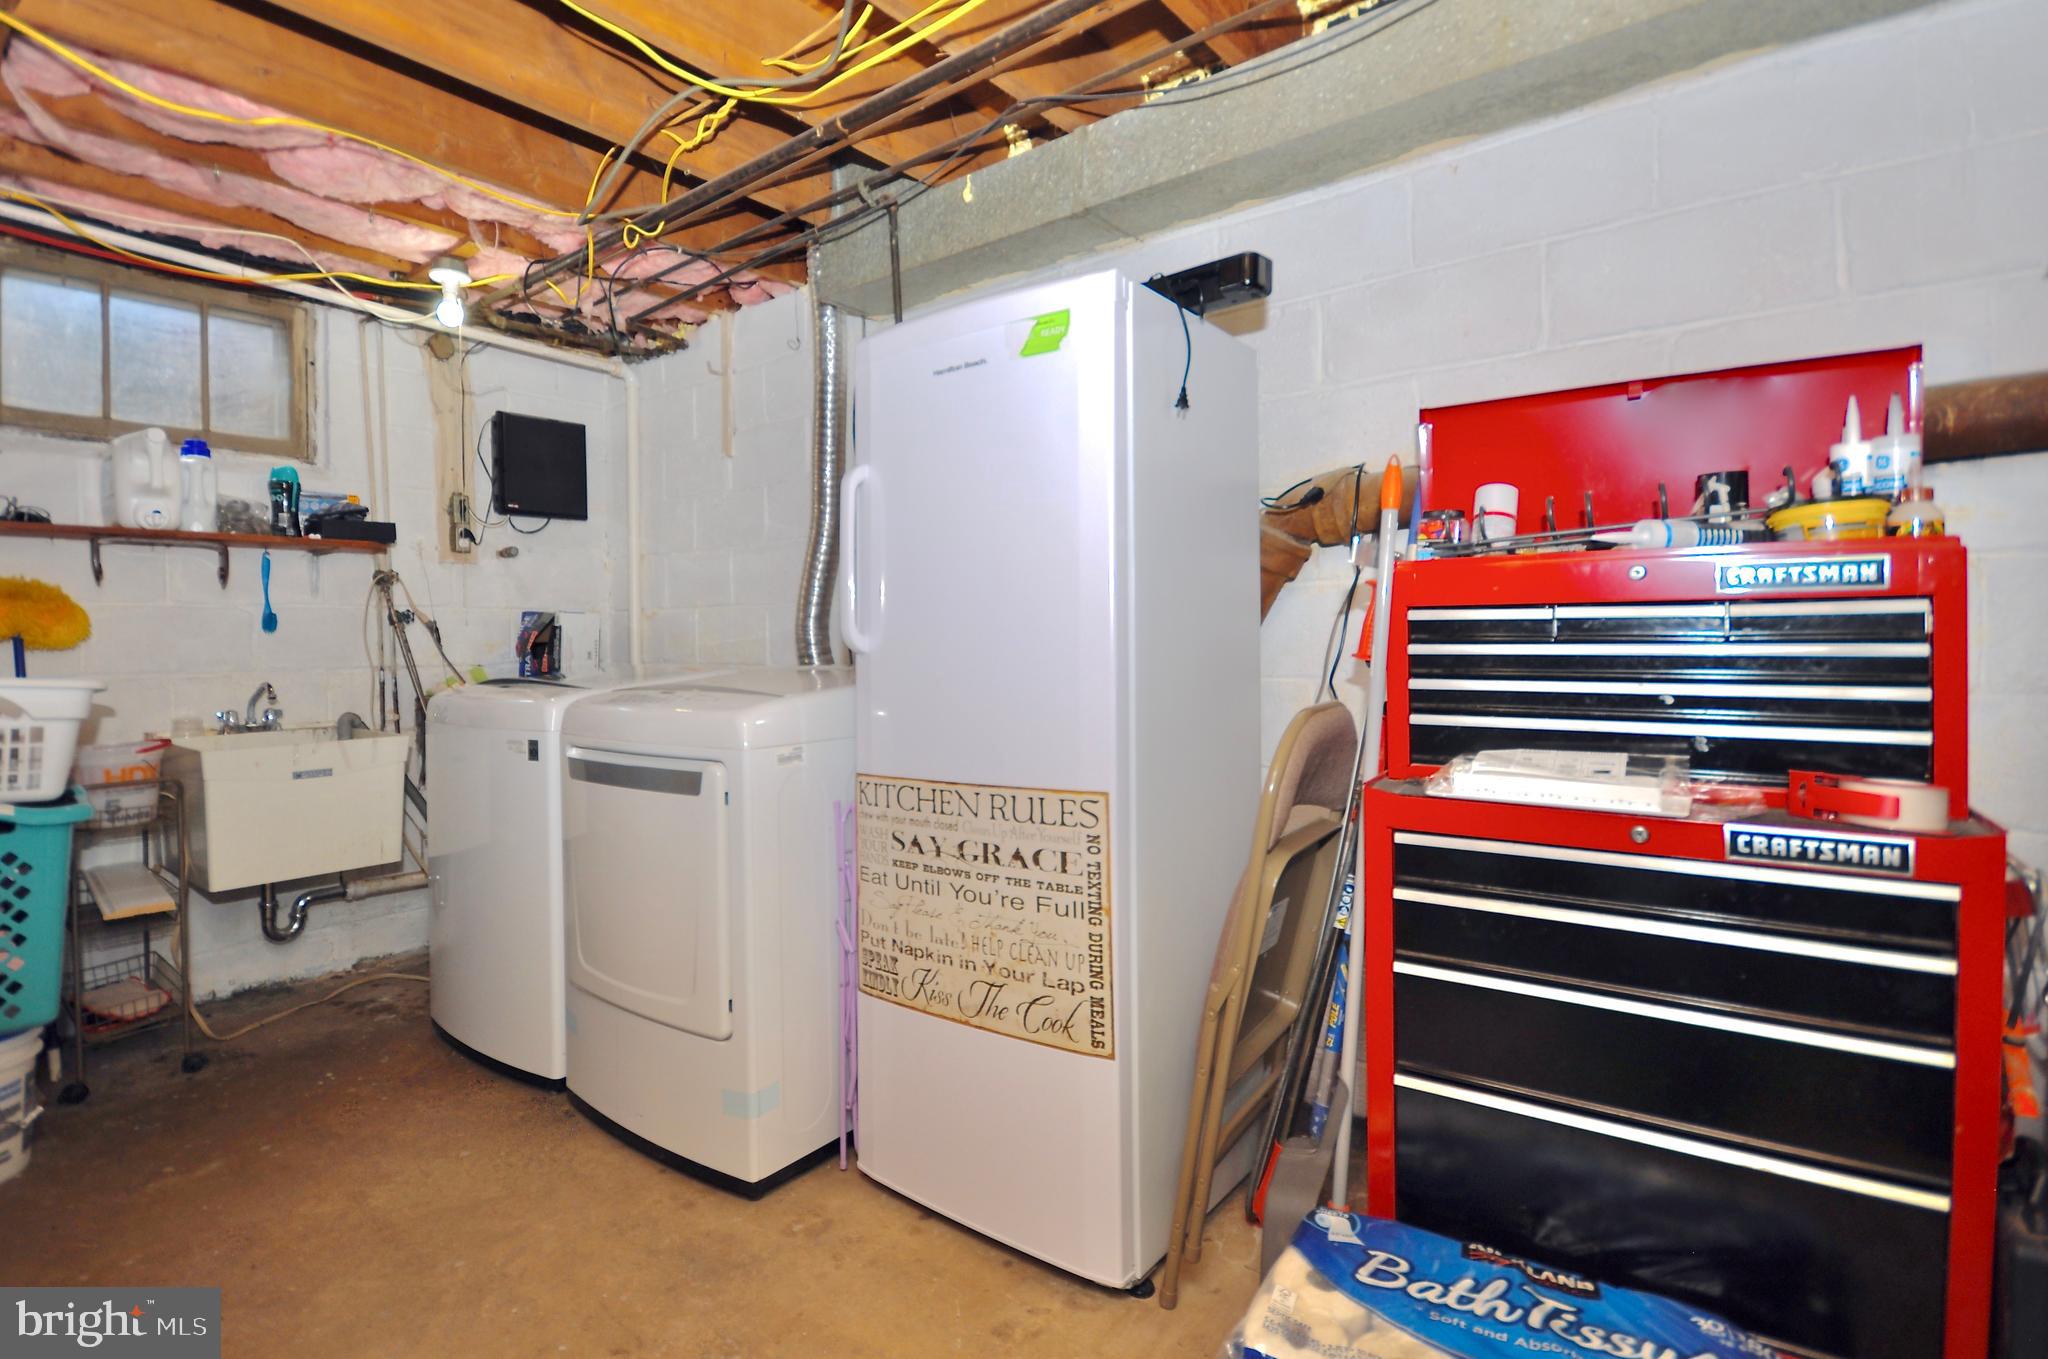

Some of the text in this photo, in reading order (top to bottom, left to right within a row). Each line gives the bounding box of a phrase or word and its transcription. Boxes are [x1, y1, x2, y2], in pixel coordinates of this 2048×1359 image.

[964, 358, 987, 369] Beach
[1725, 562, 1878, 586] CRAFTSMAN
[858, 781, 1100, 829] KITCHEN RULES
[891, 830, 1083, 877] SAY GRACE
[1736, 833, 1901, 867] CRAFTSMAN
[860, 865, 1085, 920] Eat Until You're Full
[892, 859, 1084, 895] KEEP ELBOWS OFF THE TABLE
[860, 928, 1086, 996] Put Napkin in Your Lap
[905, 919, 922, 939] be
[970, 934, 1004, 958] HELP
[1009, 941, 1058, 967] CLEAN
[1065, 951, 1086, 974] UP
[1086, 834, 1106, 1050] NO TEXTING DURING MEALS
[901, 968, 1089, 1044] Kiss The Cook
[1354, 1249, 1525, 1323] Bath
[1522, 1285, 1720, 1359] Tissu
[1429, 1311, 1468, 1330] Soft
[1472, 1325, 1509, 1343] and
